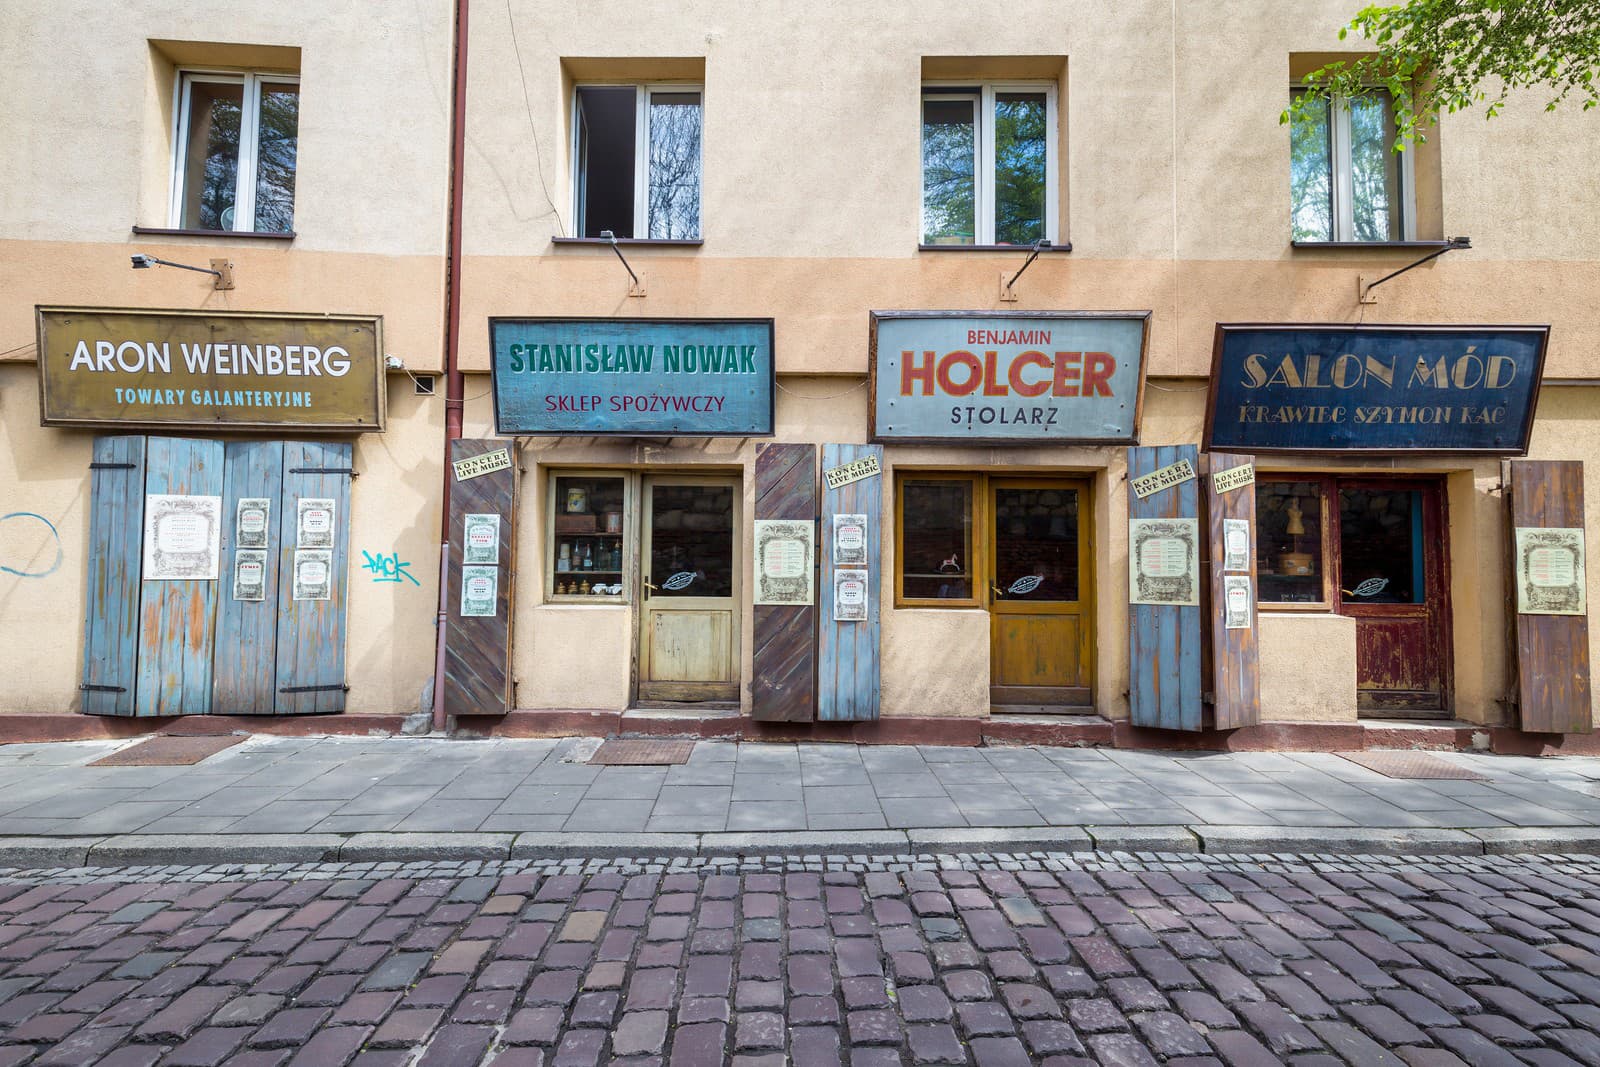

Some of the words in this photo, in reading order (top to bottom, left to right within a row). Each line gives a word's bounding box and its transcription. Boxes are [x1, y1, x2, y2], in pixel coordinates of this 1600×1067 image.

[967, 330, 1051, 345] BENJAMIN
[69, 341, 171, 373] ARON
[181, 343, 352, 377] WEINBERG
[510, 343, 655, 374] STANISŁAW
[663, 345, 757, 375] NOWAK
[1240, 353, 1396, 389] SALON
[1407, 346, 1516, 389] MÓD
[901, 351, 1116, 397] HOLCER
[115, 387, 185, 405] TOWARY
[191, 388, 312, 407] GALANTERYJNE
[545, 395, 603, 412] SKLEP
[610, 392, 726, 412] SPOŻYWCZY
[951, 406, 1058, 424] STOLARZ
[1239, 406, 1347, 424] KRAWIEC
[1353, 406, 1451, 425] SZYMON
[1459, 407, 1505, 424] KAC
[456, 452, 507, 471] KONCERT
[458, 467, 479, 478] LIVE
[480, 458, 509, 472] MUSIC
[827, 459, 876, 480] KONCERT
[829, 474, 850, 486] LIVE
[851, 464, 879, 479] MUSIC
[1134, 462, 1189, 489] KONCERT
[1137, 482, 1159, 495] LIVE
[1161, 469, 1193, 486] MUSIC
[1215, 467, 1252, 484] KONCERT
[1216, 480, 1232, 491] LIVE
[1233, 473, 1254, 485] MUSIC
